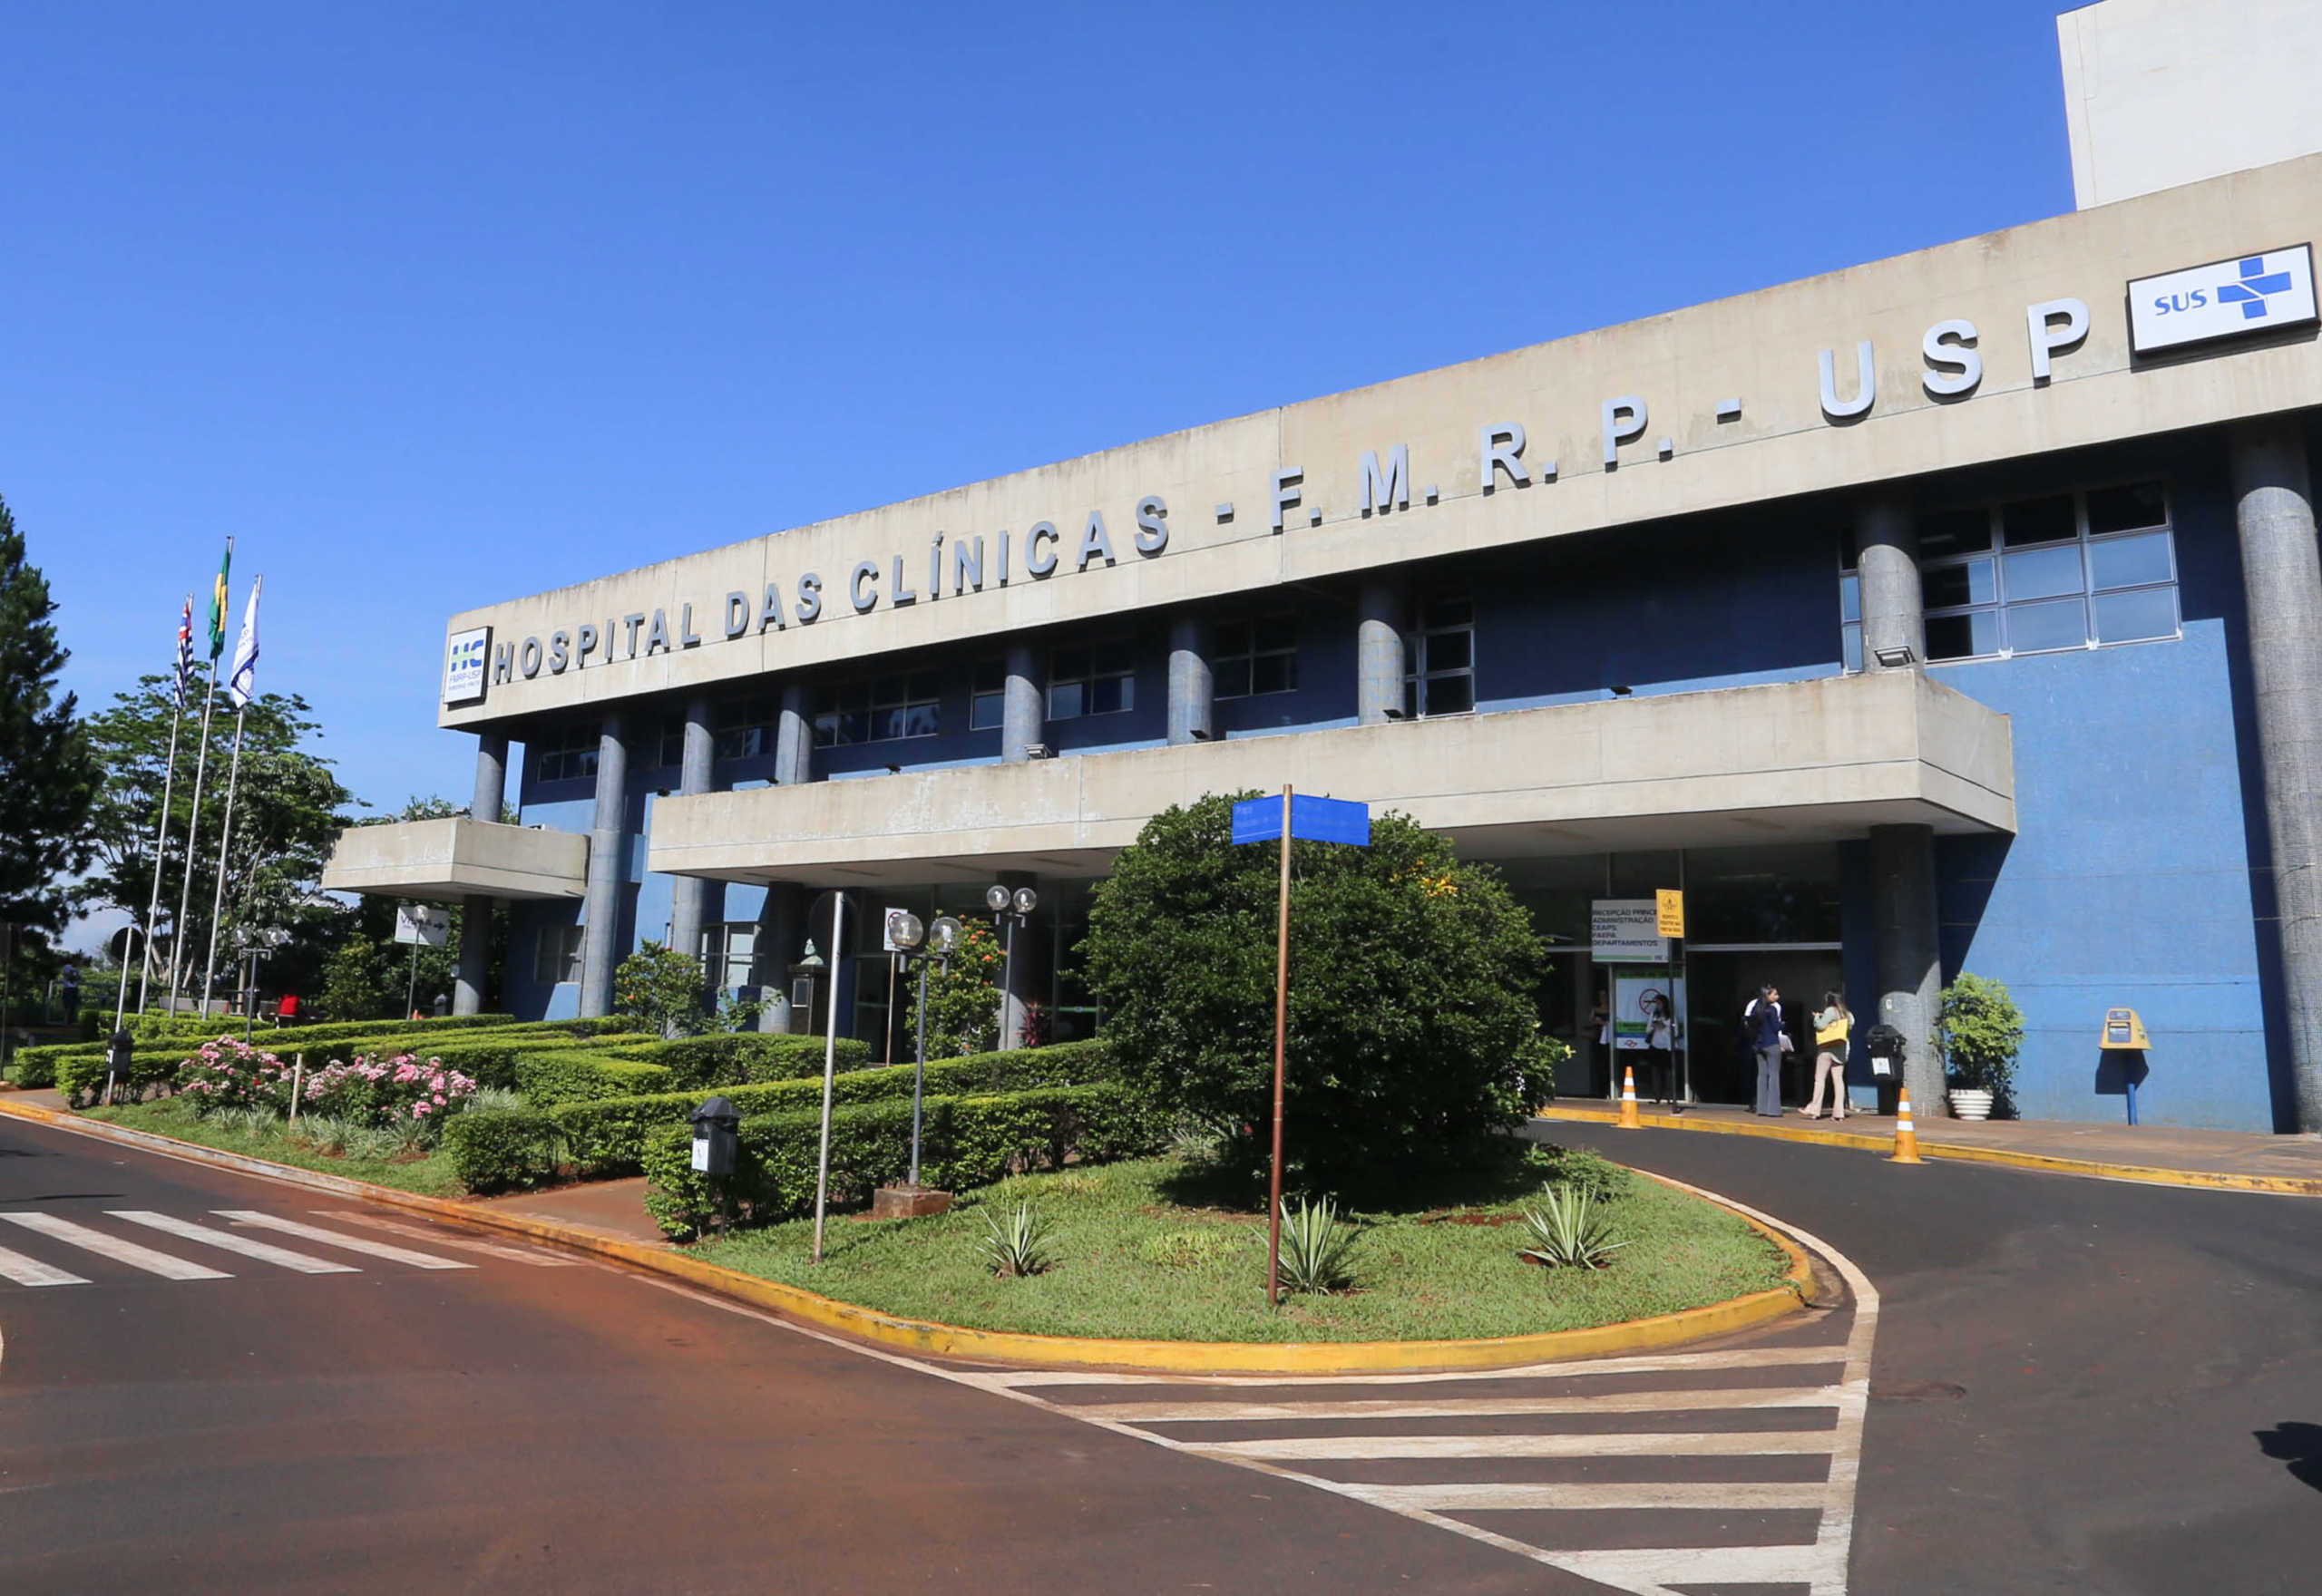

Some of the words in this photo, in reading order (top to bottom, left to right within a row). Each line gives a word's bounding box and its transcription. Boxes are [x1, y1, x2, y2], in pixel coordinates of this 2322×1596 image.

[2153, 288, 2208, 316] SUS
[493, 603, 700, 684] HOSPITAL
[725, 572, 822, 640] DAS
[850, 495, 1170, 615] CLÍNICAS
